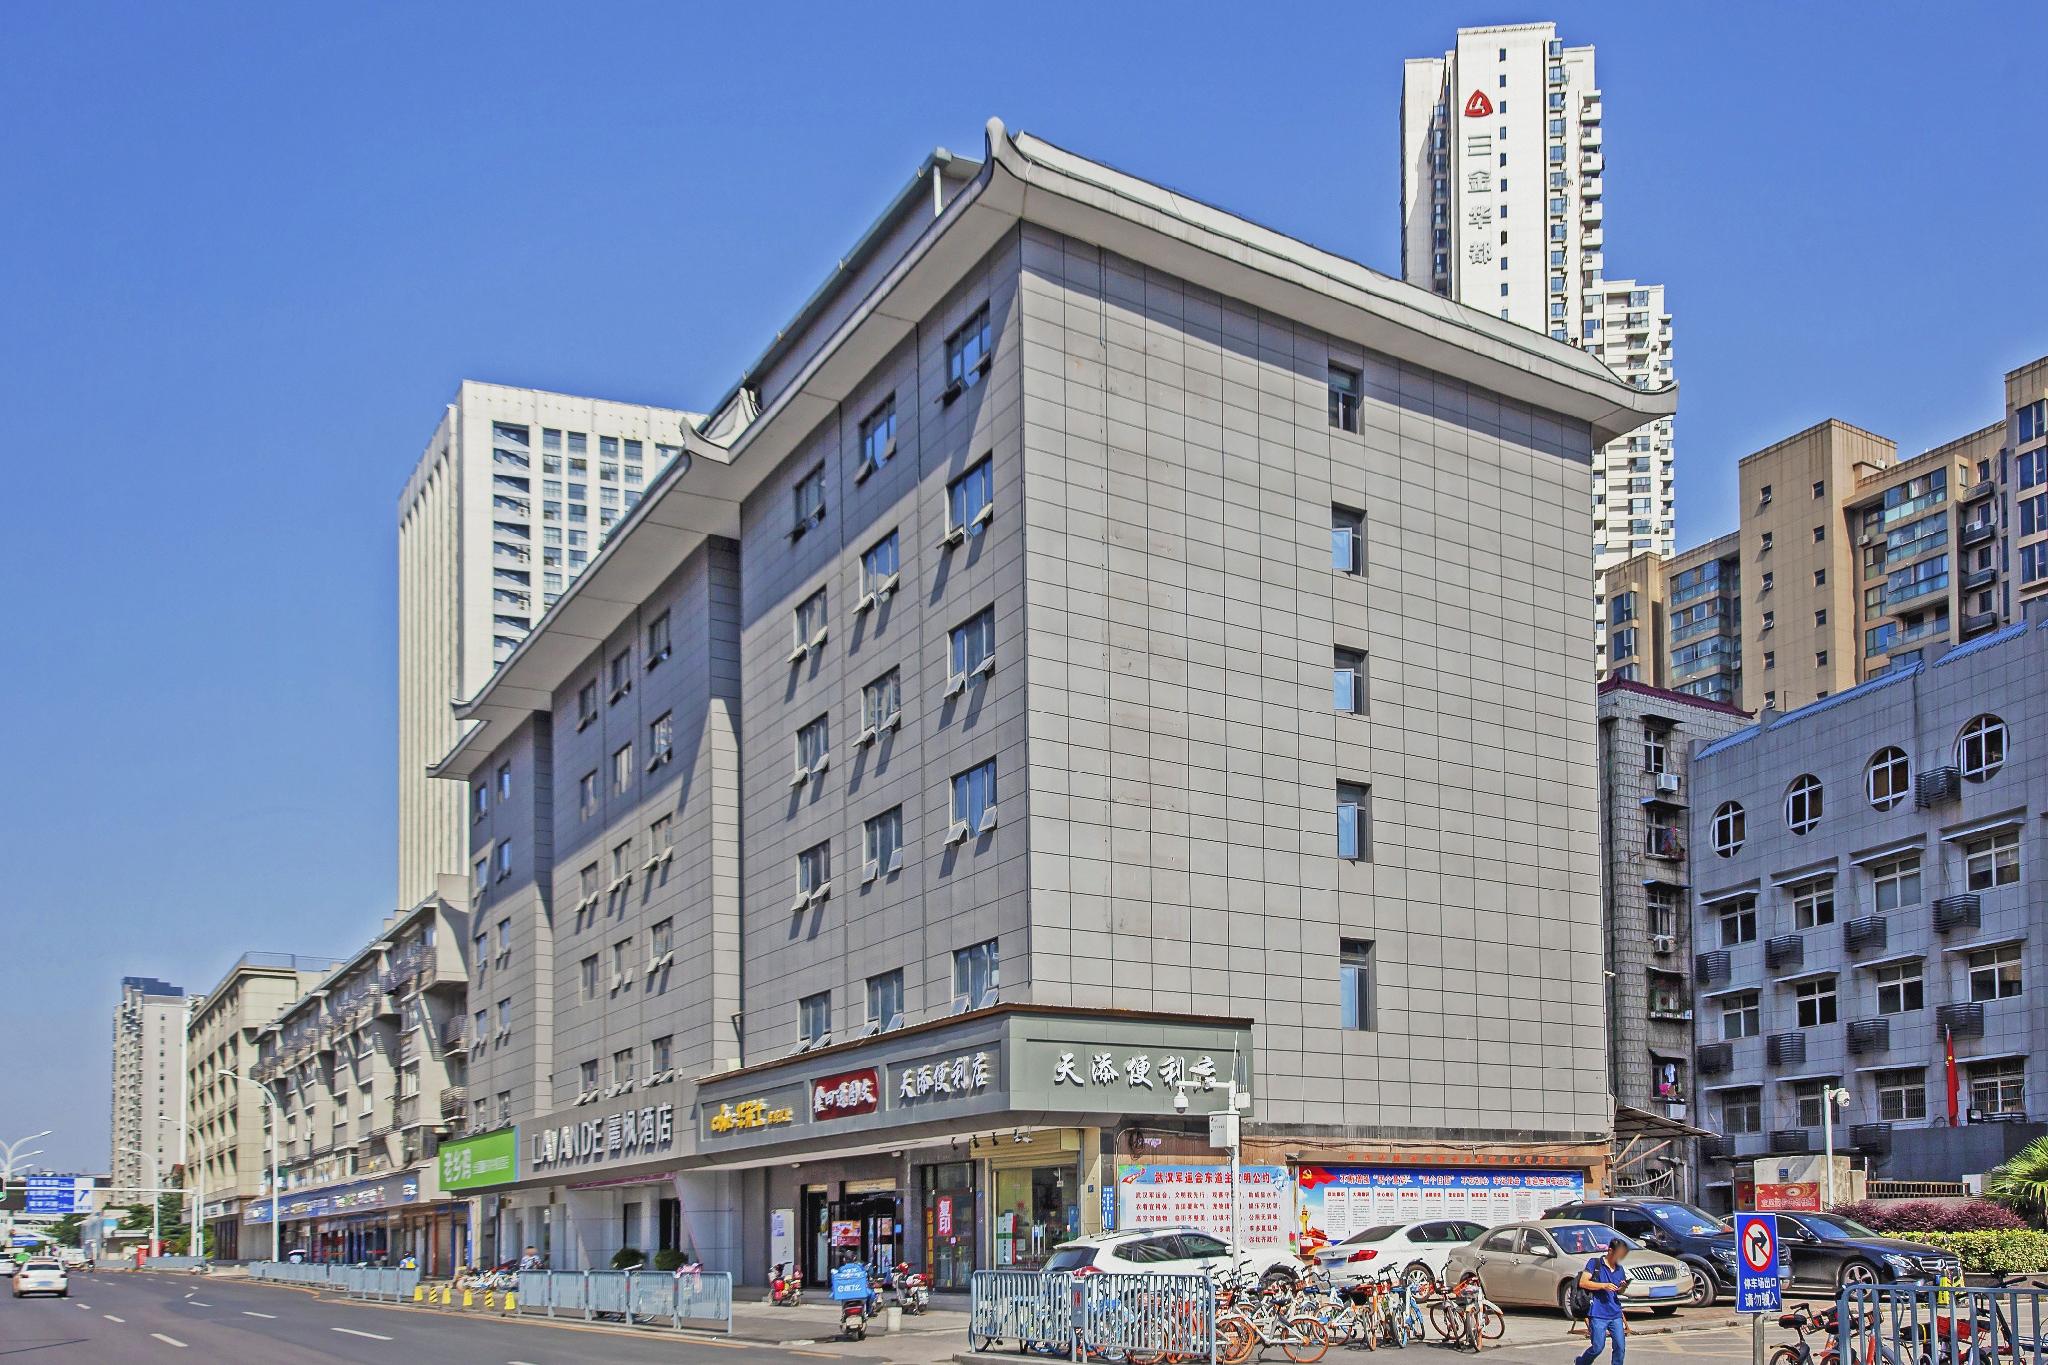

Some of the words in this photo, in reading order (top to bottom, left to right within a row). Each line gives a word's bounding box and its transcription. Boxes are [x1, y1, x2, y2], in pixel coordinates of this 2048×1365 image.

[898, 1051, 991, 1099] 天添便利店
[1054, 1052, 1218, 1092] 天添便利店
[531, 1118, 605, 1165] LAVANDE
[1743, 1277, 1777, 1290] 停车场出口
